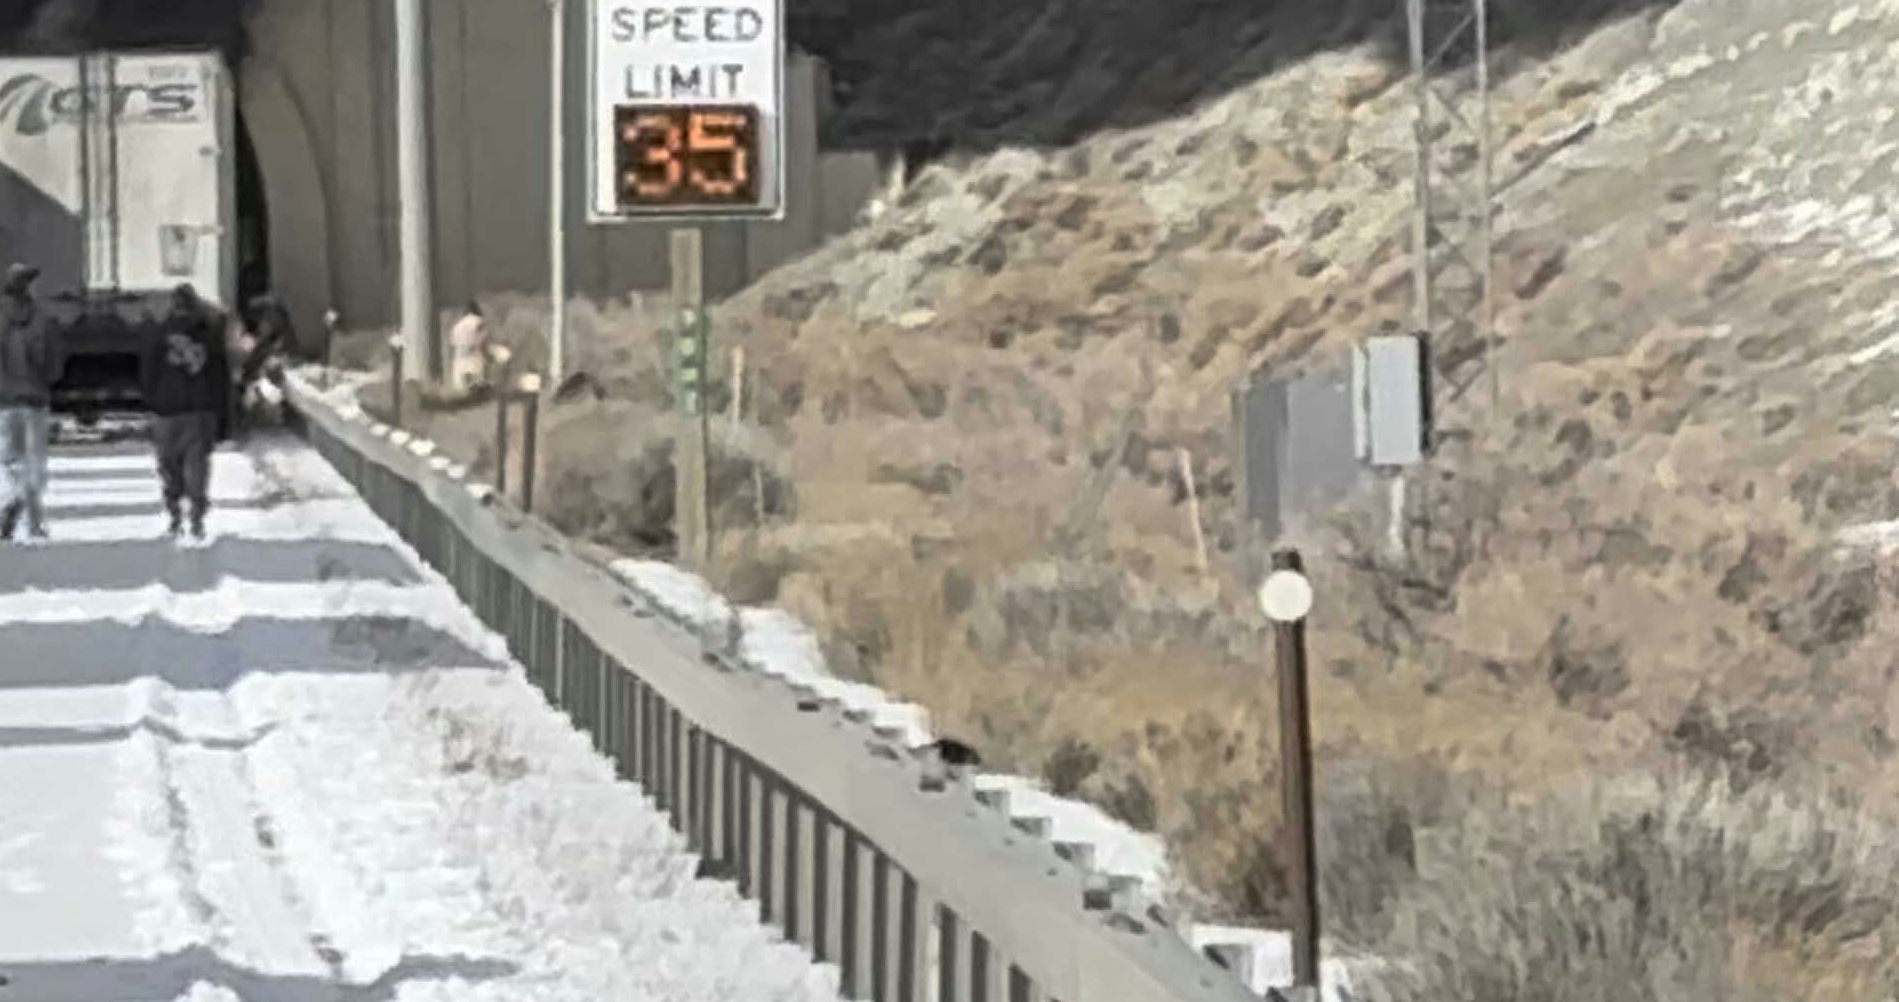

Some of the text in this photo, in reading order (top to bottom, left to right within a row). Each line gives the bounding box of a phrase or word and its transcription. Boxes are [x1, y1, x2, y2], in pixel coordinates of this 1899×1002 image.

[610, 6, 763, 43] SPEED
[624, 63, 744, 99] LIMIT
[622, 111, 747, 195] 35
